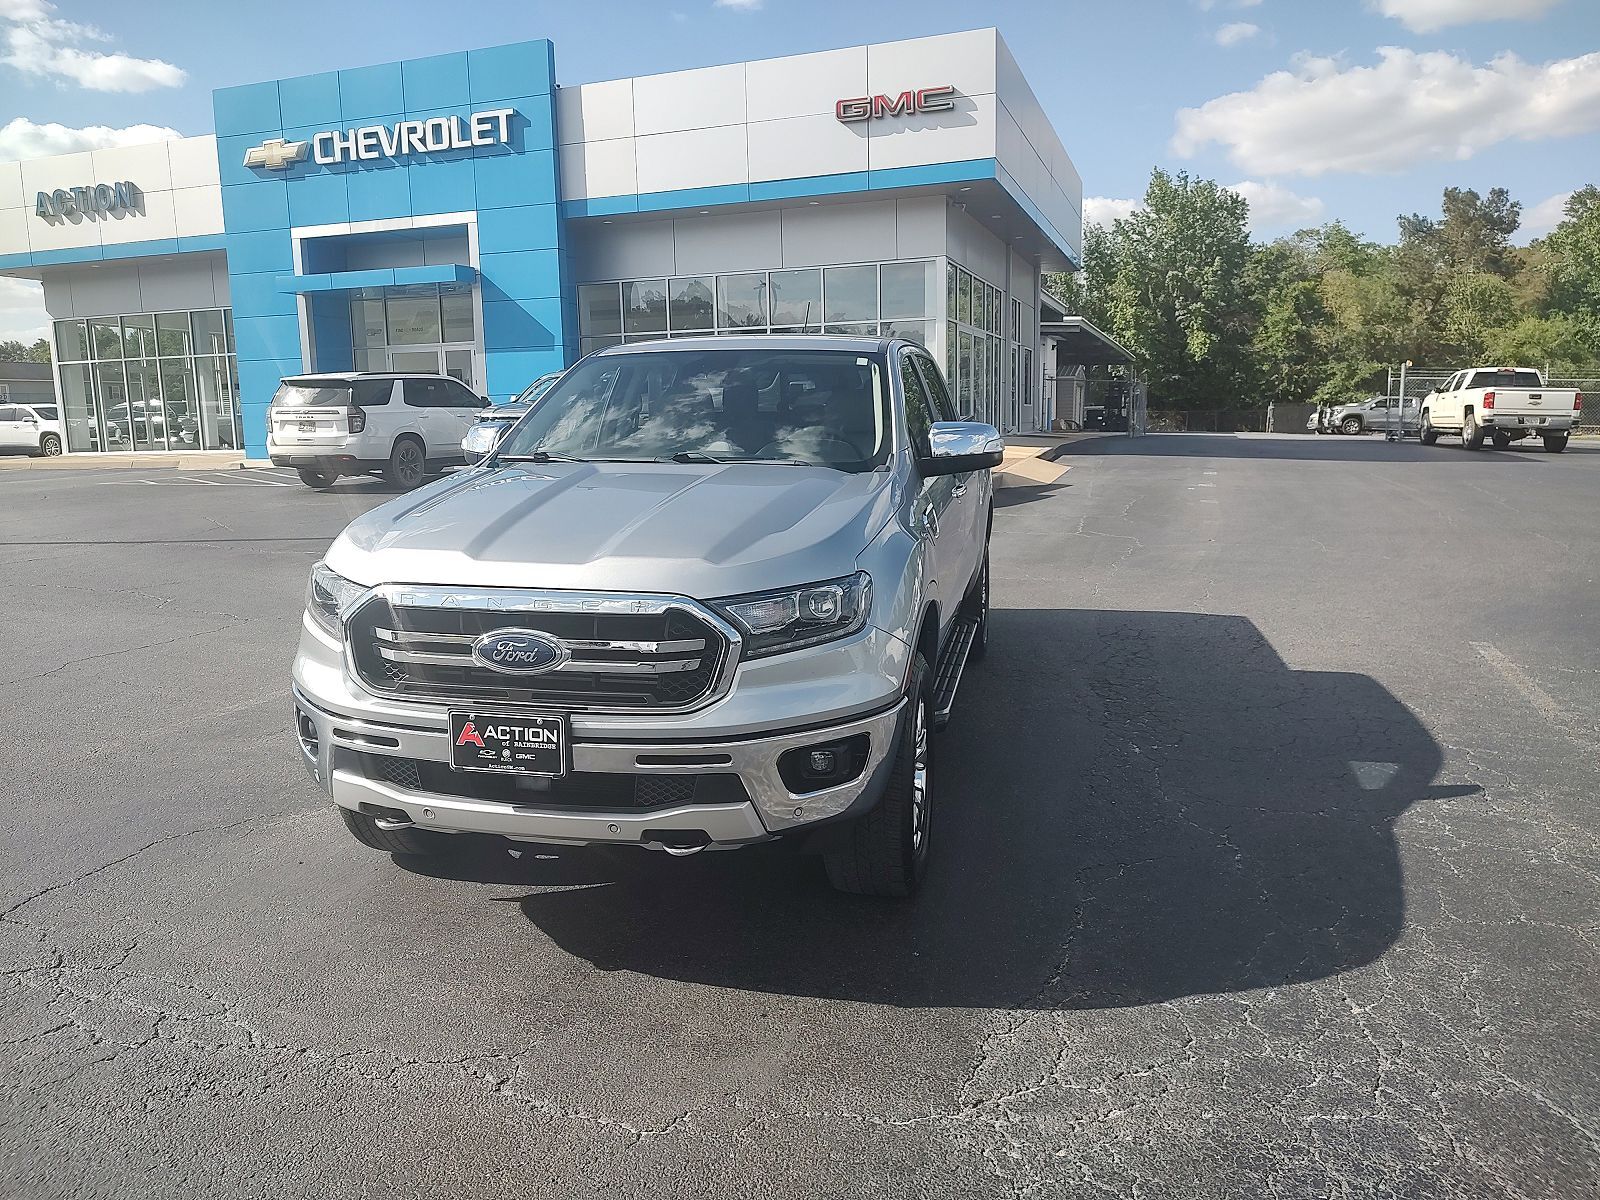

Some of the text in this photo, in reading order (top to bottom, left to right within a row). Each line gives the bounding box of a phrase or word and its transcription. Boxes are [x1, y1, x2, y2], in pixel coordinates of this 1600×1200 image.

[835, 84, 955, 122] GMC
[313, 108, 514, 165] CHEVROLET
[36, 181, 136, 216] ACTION
[401, 593, 651, 613] RANGER
[492, 640, 539, 663] Ford
[484, 725, 558, 743] ACTION
[513, 741, 557, 750] BAINBRIDGE
